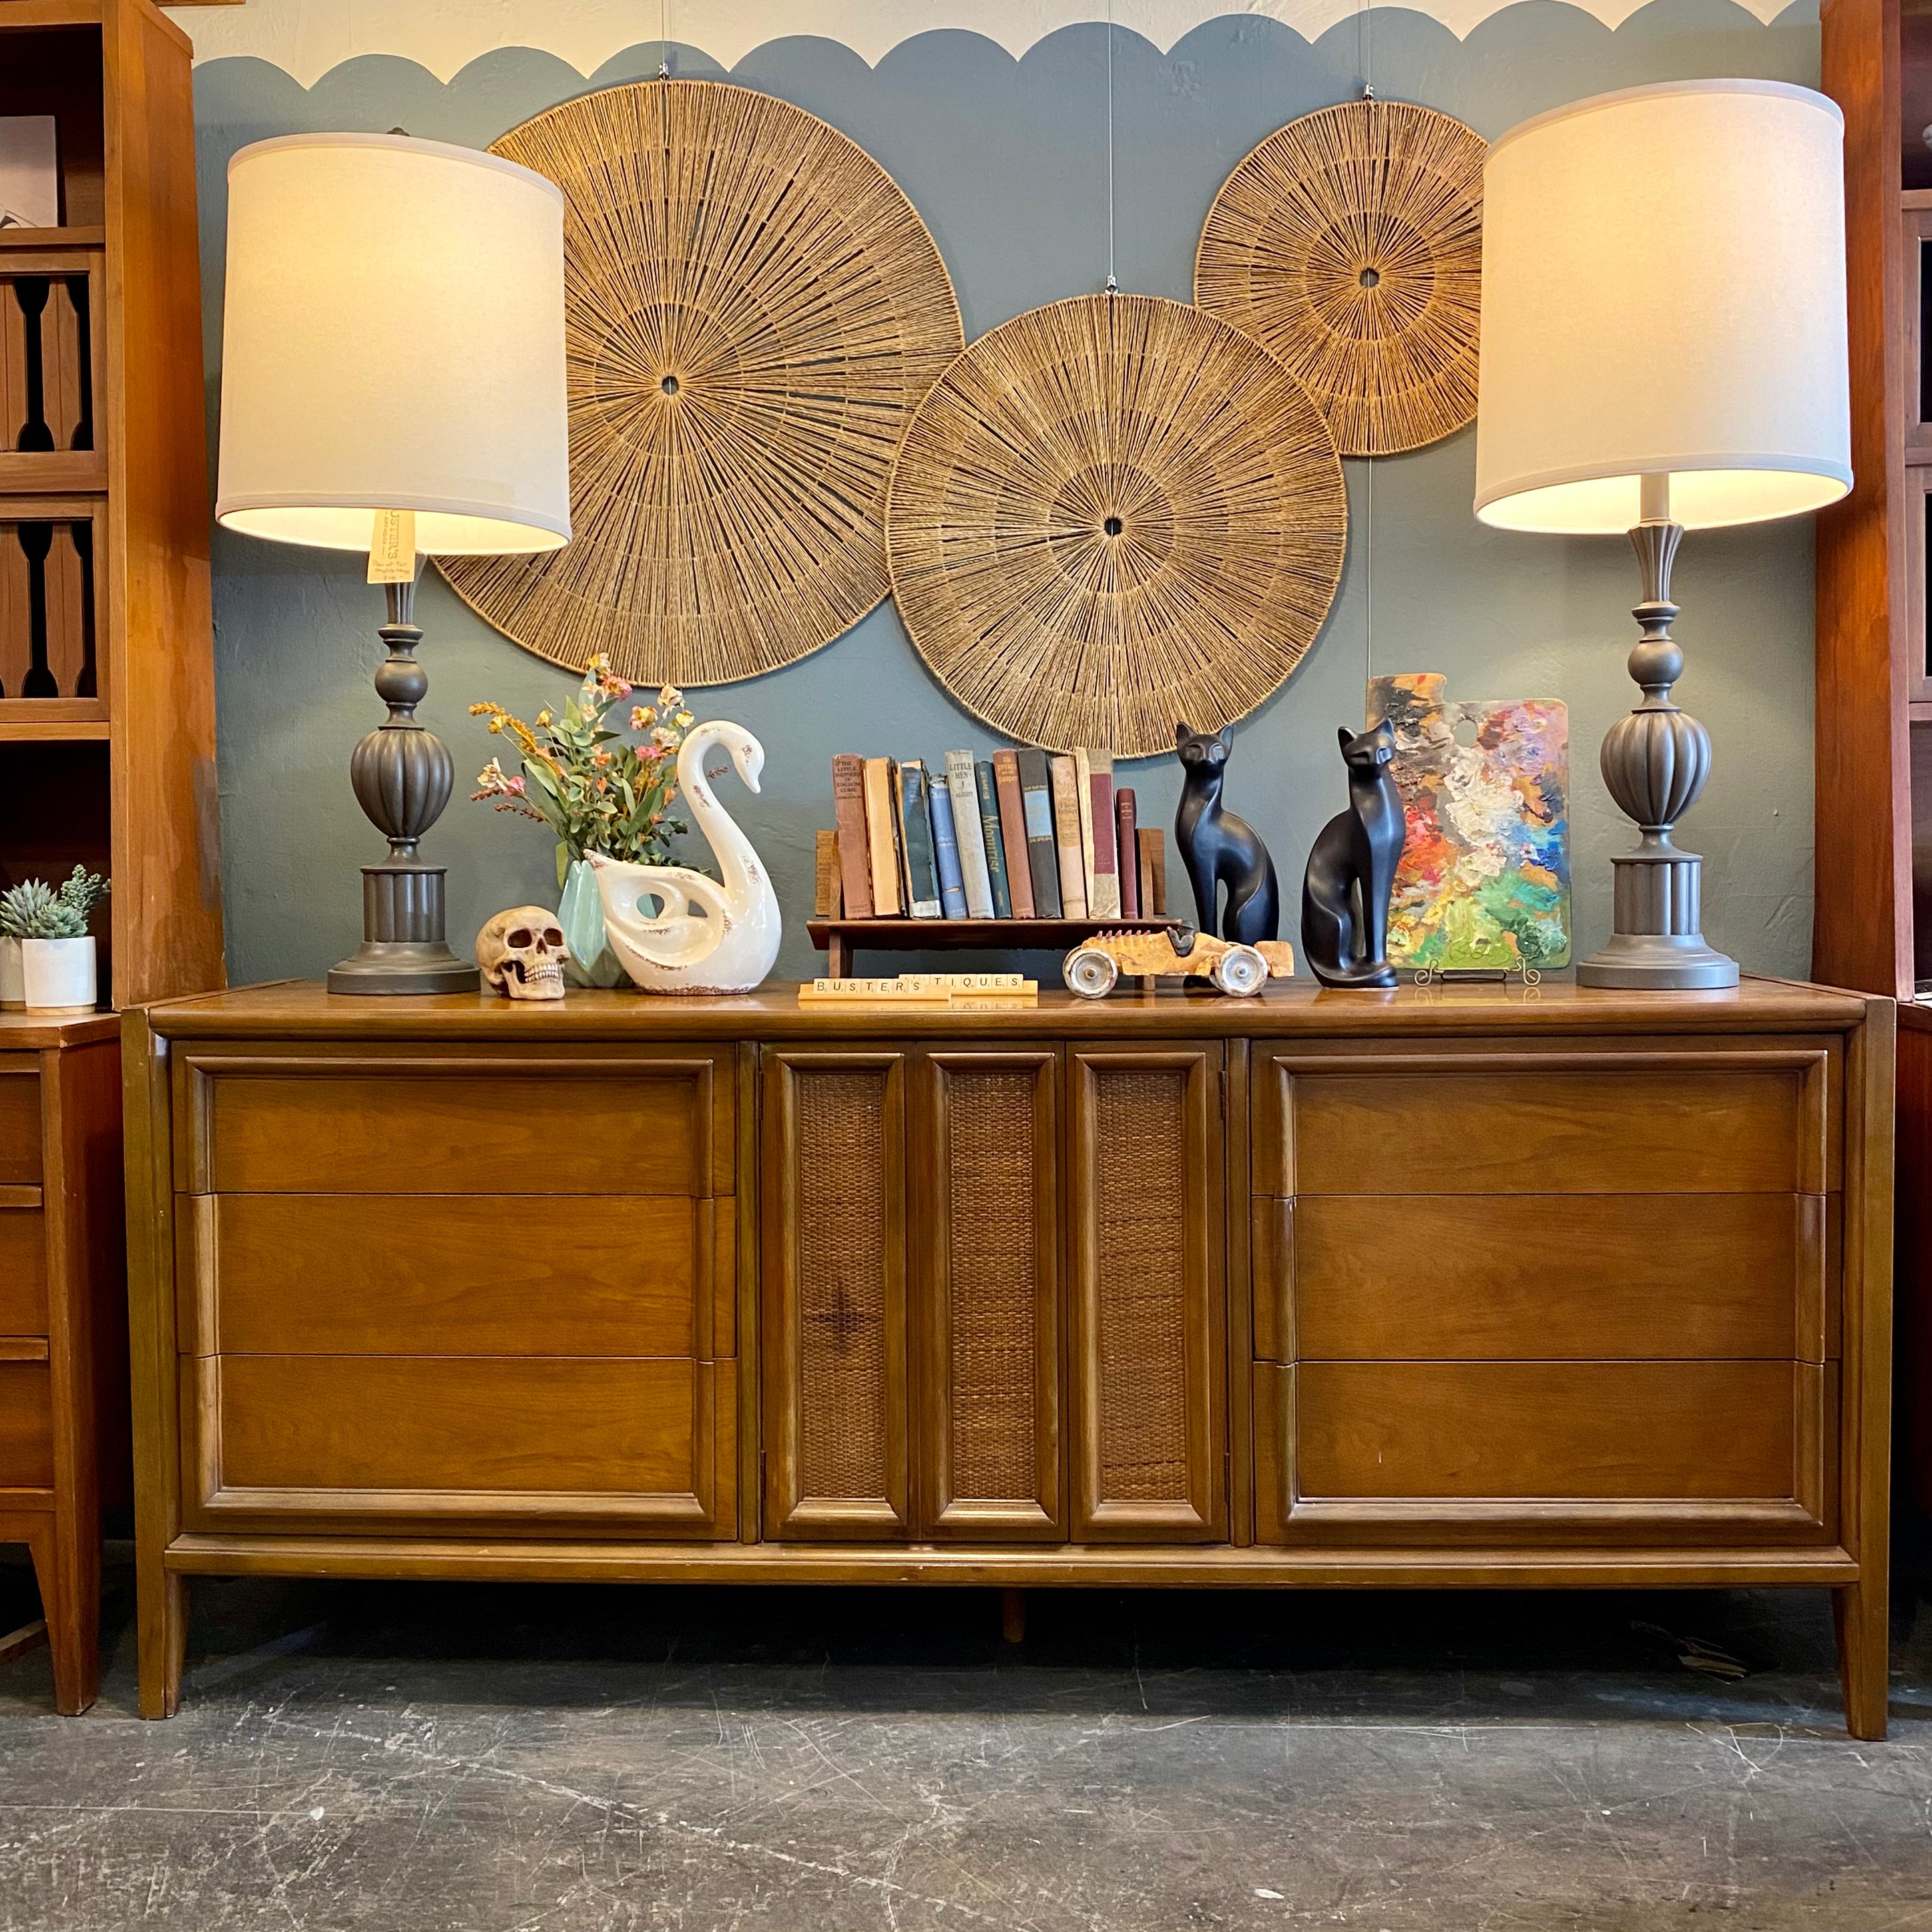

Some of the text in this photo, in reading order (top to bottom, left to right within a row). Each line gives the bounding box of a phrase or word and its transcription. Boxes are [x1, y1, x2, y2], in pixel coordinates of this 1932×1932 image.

[388, 509, 400, 559] USTER'S
[949, 763, 972, 771] LITTLE
[817, 982, 919, 991] BUSTERS
[905, 977, 1018, 987] TIQUES
